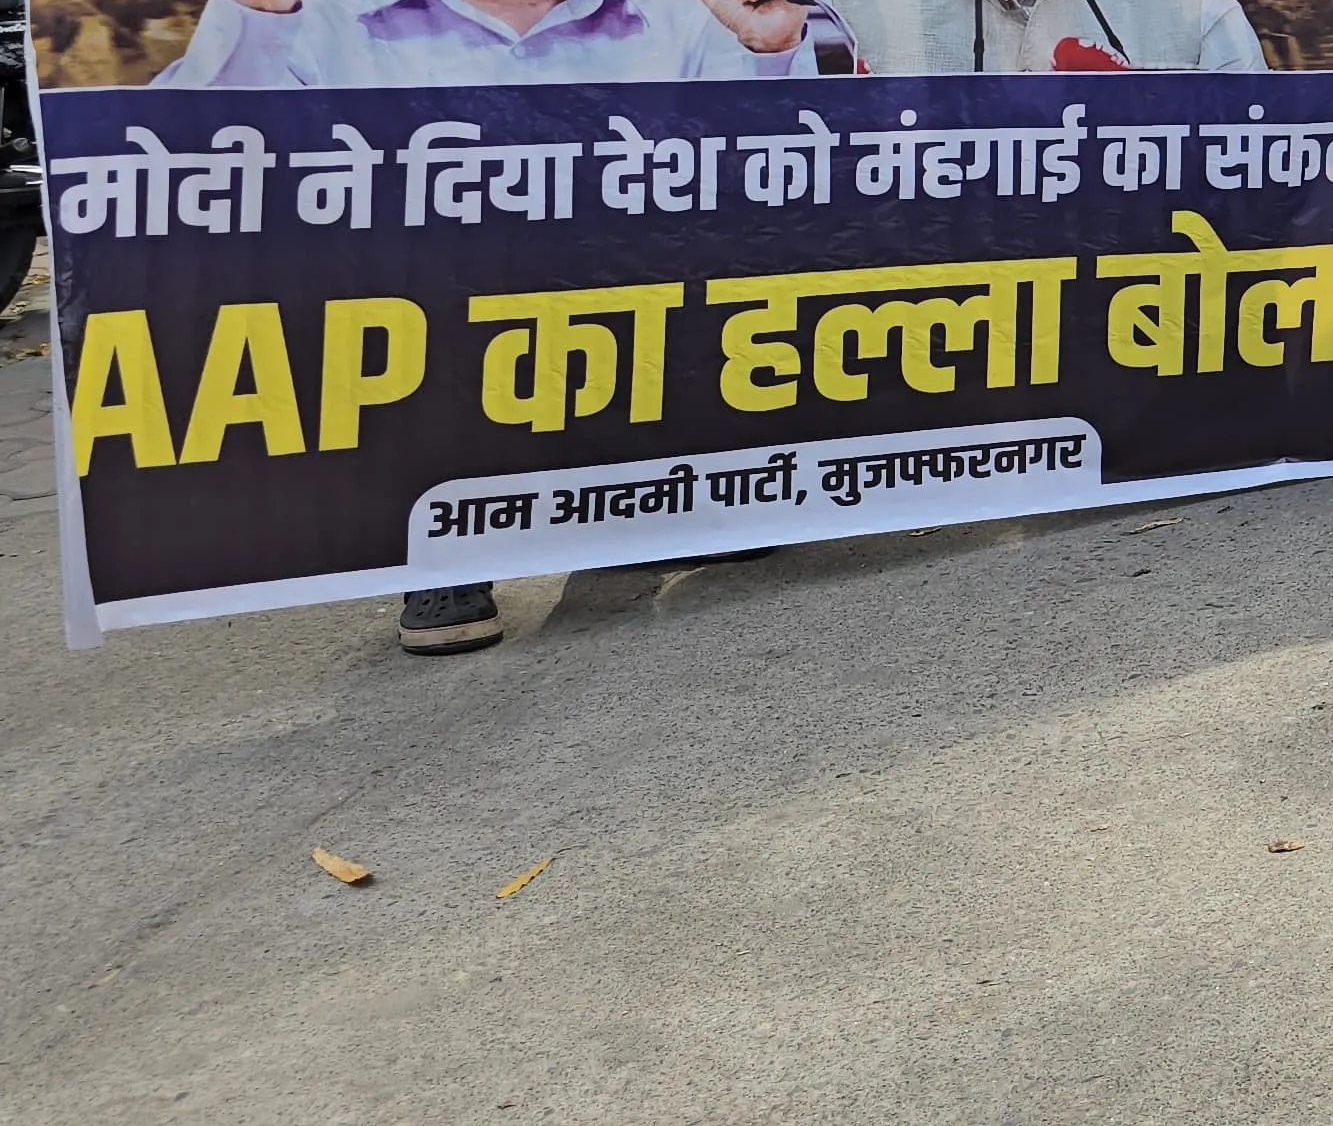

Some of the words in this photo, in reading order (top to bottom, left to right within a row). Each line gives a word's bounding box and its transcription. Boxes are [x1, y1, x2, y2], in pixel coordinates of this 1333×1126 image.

[50, 125, 277, 239] मोदी
[288, 124, 384, 230] ने
[398, 120, 583, 228] दिया
[593, 115, 728, 215] देश
[737, 110, 839, 207] को
[850, 104, 1090, 203] मंहगाई
[1098, 124, 1190, 193] का
[71, 296, 429, 479] AAP
[467, 281, 686, 434] का
[705, 256, 1078, 414] हल्ला
[428, 492, 539, 538] आम
[549, 463, 699, 525] आदमी
[705, 450, 808, 508] पार्टी,
[817, 433, 1087, 507] मुजफ्फरनगर
